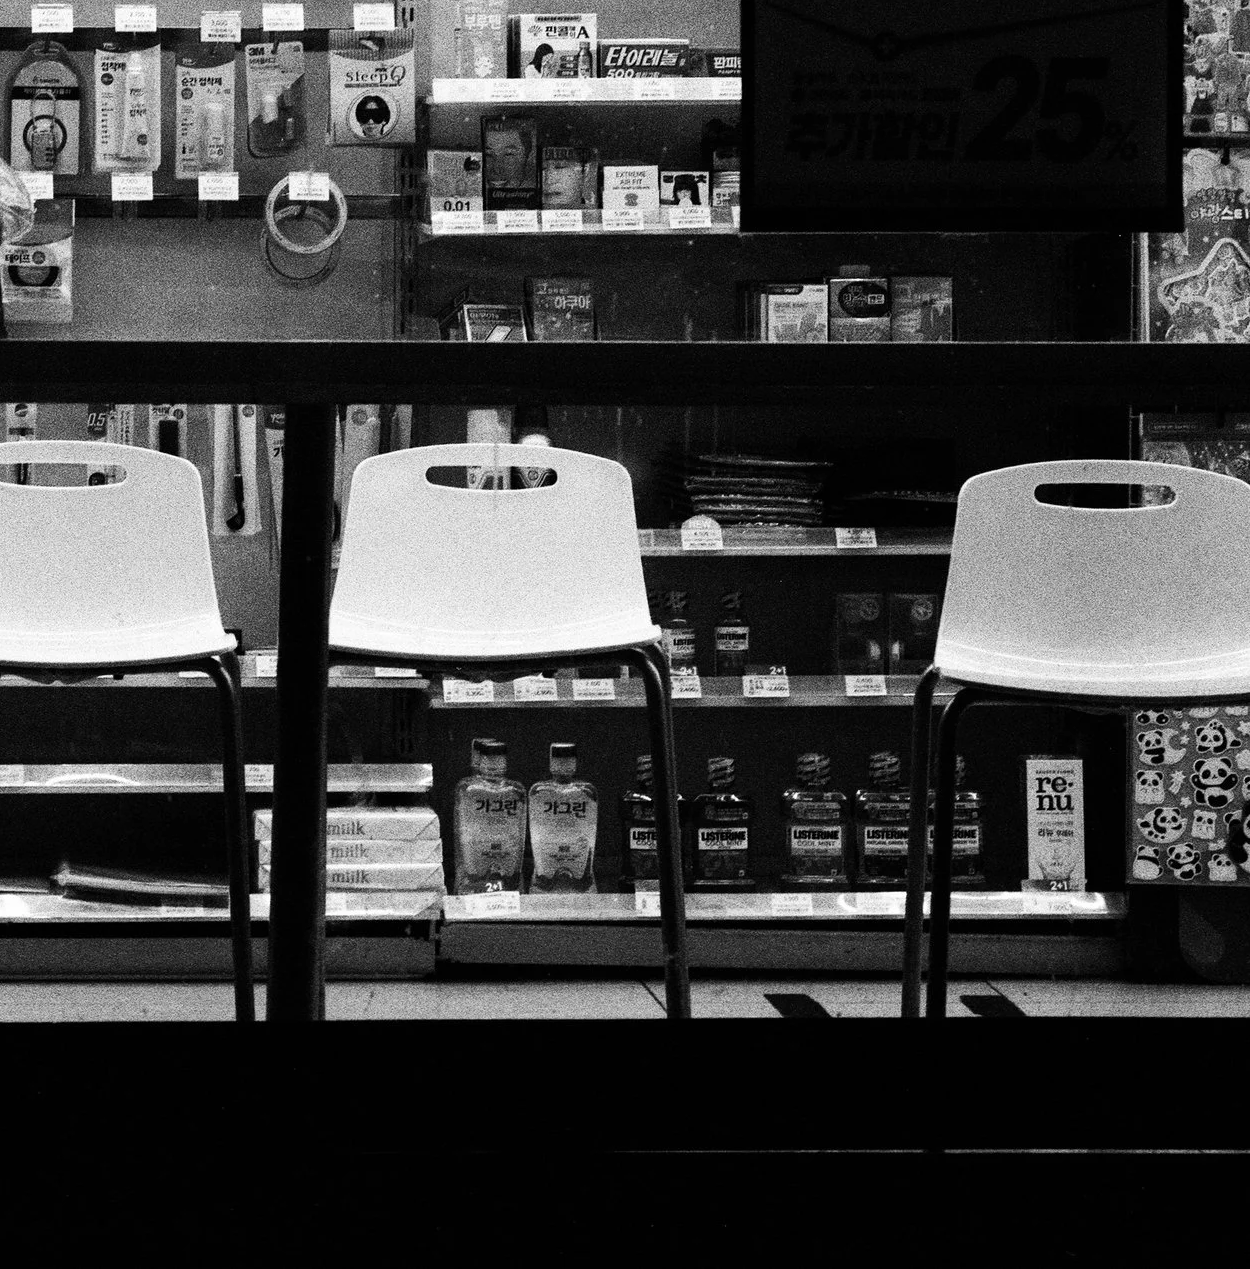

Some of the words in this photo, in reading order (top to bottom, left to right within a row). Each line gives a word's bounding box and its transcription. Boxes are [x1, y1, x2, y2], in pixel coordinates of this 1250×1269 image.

[248, 47, 266, 57] 3M
[605, 46, 680, 67] 타이레놀
[101, 61, 127, 72] 접착제
[180, 76, 198, 88] 순간
[199, 76, 223, 88] 접착제
[345, 71, 388, 85] Sleep
[443, 201, 471, 212] 0.01
[554, 294, 592, 310] 아쿠아
[87, 413, 107, 428] 0.5
[769, 665, 787, 675] 2+1
[475, 797, 518, 817] 가그린
[1035, 794, 1074, 811] nu
[543, 800, 587, 819] 가그린
[632, 830, 657, 841] LISTE
[701, 830, 747, 842] LISTERINE
[793, 828, 840, 840] LISTERINE
[866, 829, 908, 840] LISTERIN
[485, 881, 503, 892] 2+1
[1050, 881, 1068, 891] 2+1
